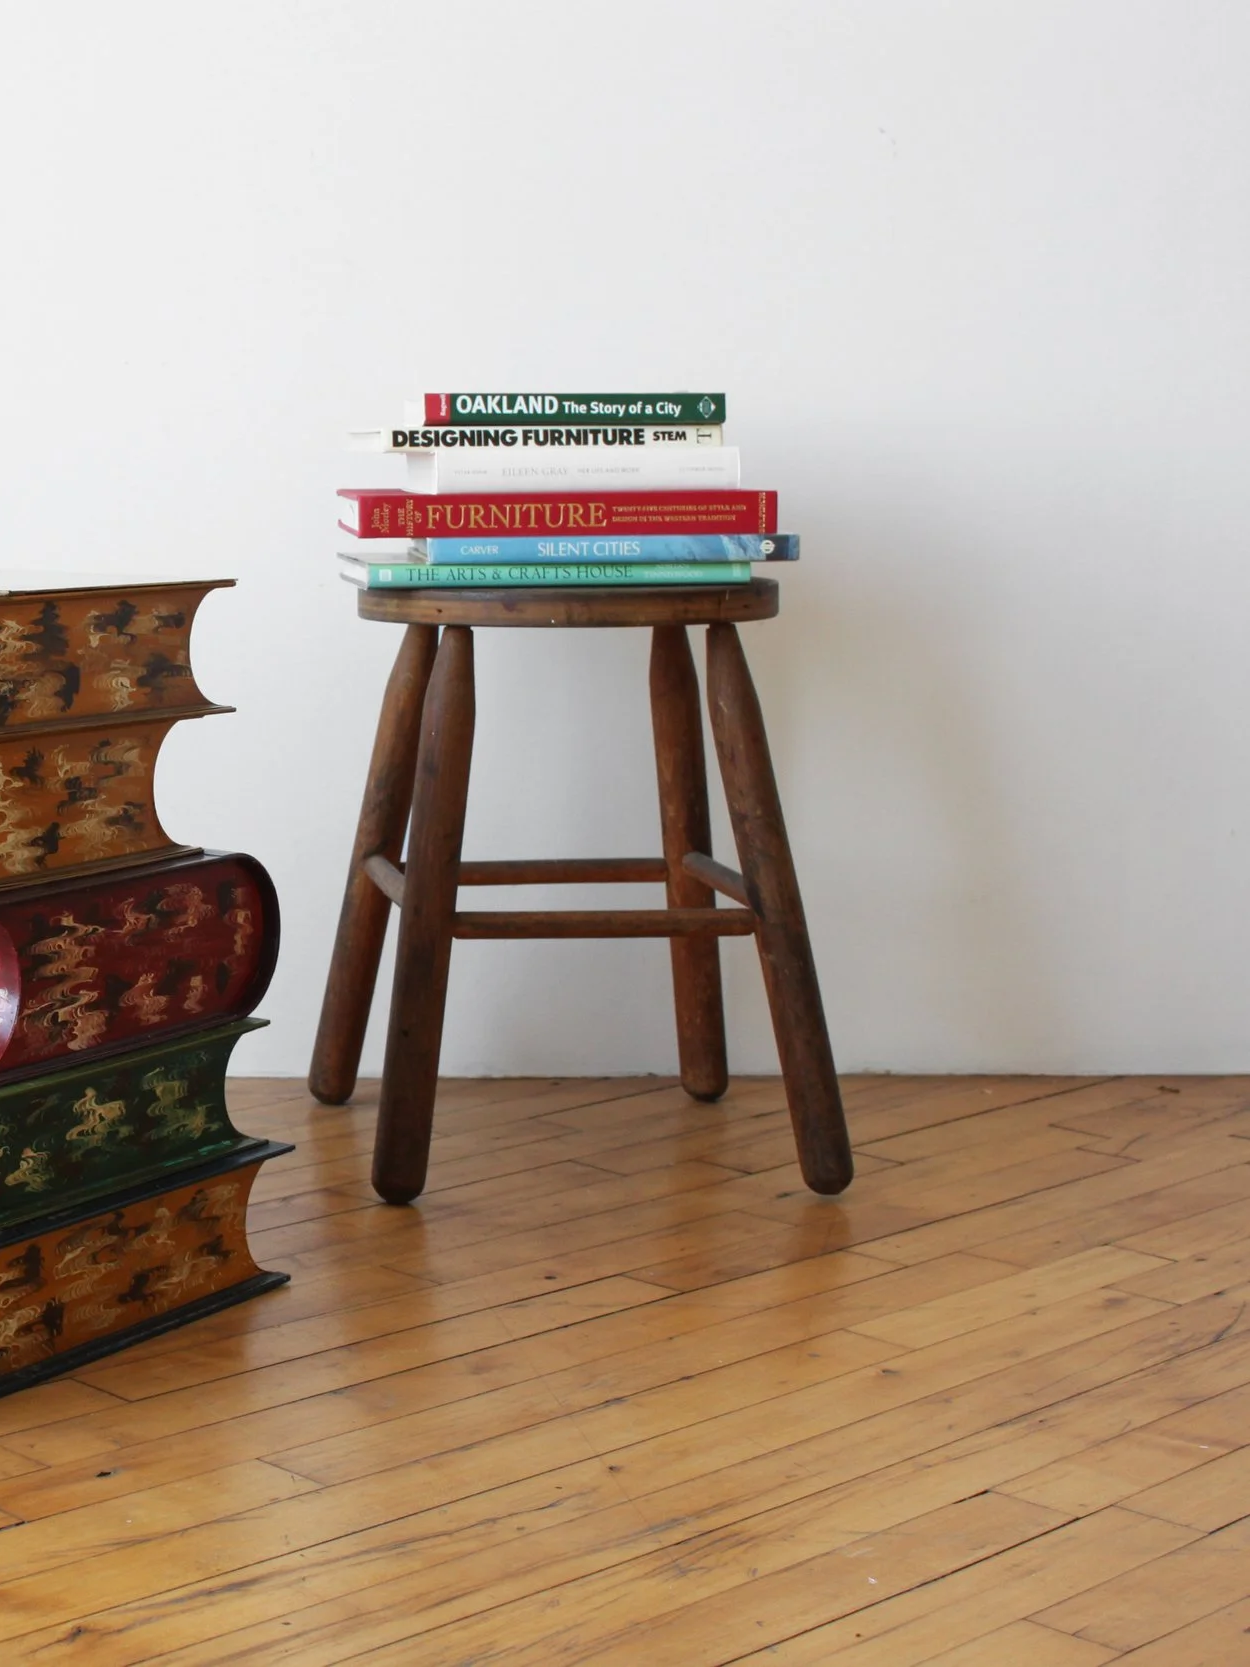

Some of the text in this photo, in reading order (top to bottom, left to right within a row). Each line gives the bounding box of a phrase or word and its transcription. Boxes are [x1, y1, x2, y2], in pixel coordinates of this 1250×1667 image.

[455, 395, 682, 417] OAKLAND The Story of a City
[392, 429, 687, 447] DESIGNING FURNITURE STEM
[371, 508, 380, 528] John
[406, 499, 414, 536] HISTORY
[414, 511, 422, 524] OF
[426, 503, 607, 529] FURNITURE
[460, 541, 641, 557] CARVER SILENT CITIES
[406, 565, 634, 581] THE ARTS & CRAFTS HOUSE
